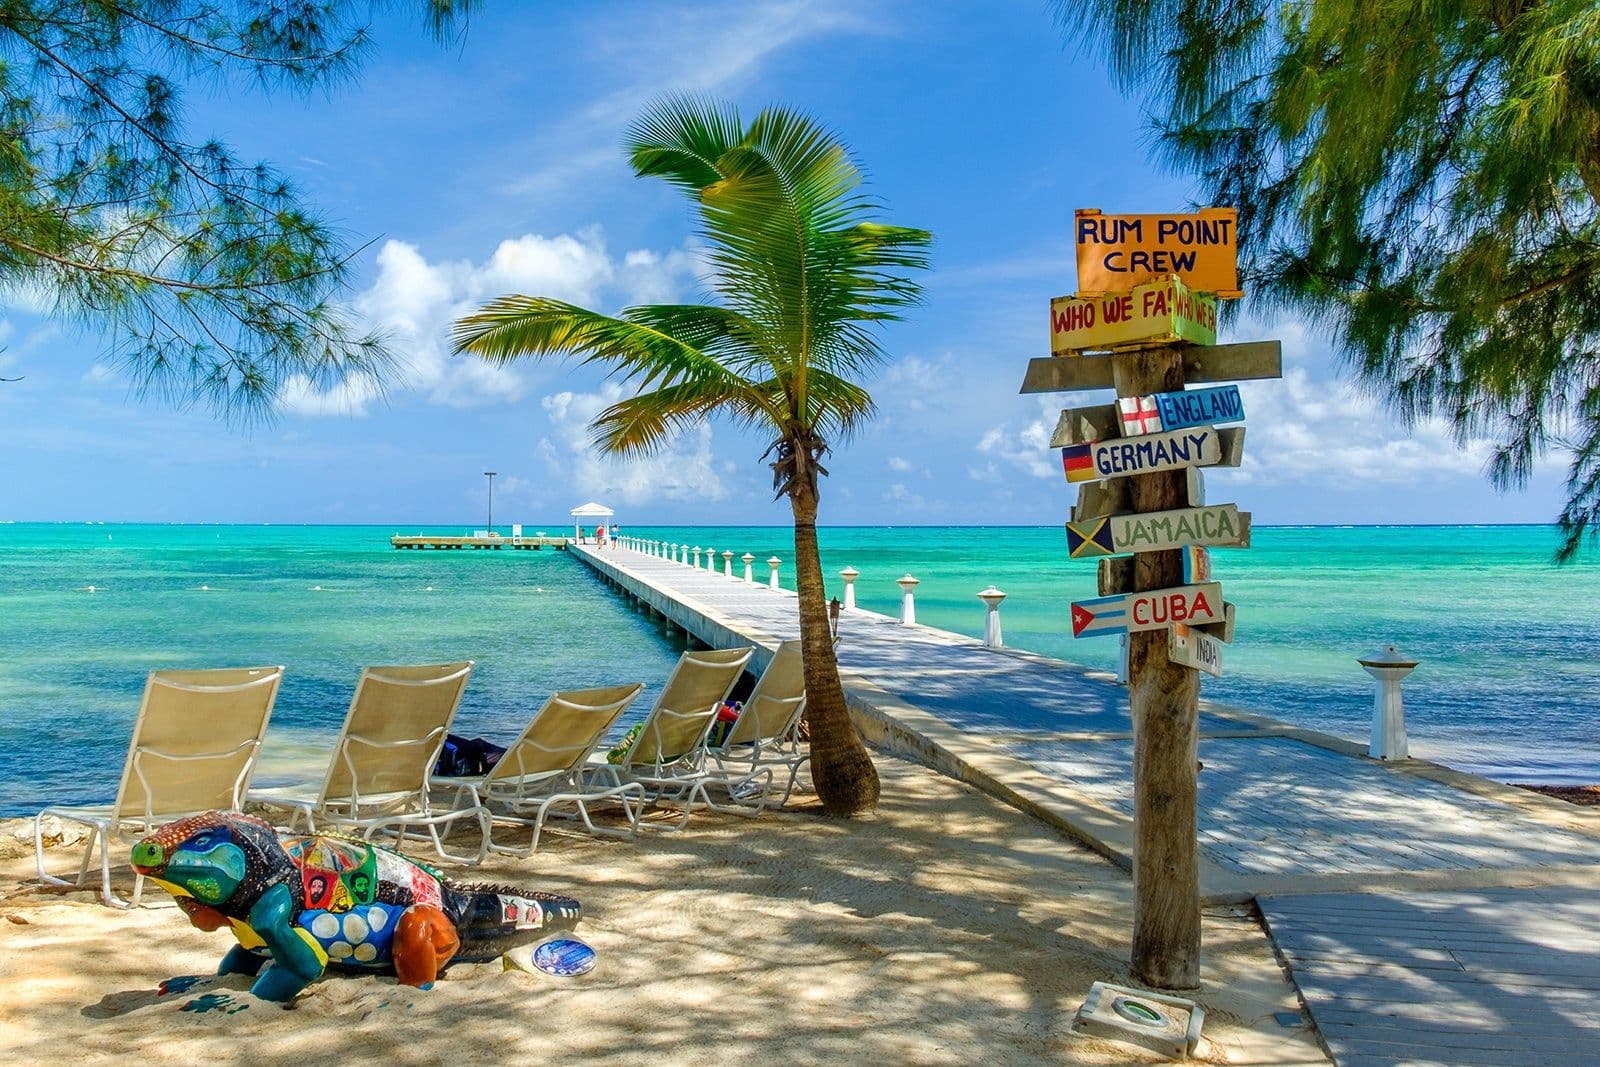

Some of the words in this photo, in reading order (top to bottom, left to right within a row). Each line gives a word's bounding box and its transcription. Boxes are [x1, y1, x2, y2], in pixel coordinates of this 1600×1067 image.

[1078, 219, 1142, 244] RUM
[1158, 219, 1232, 246] POINT
[1103, 251, 1197, 273] CREW
[1052, 303, 1096, 334] WHO
[1102, 296, 1133, 324] WE
[1176, 293, 1193, 322] WHO
[1195, 299, 1207, 328] WE
[1164, 388, 1240, 426] ENGLAND
[1096, 431, 1208, 475] GERMANY
[1115, 509, 1236, 547] JAMAICA
[1133, 591, 1213, 625] CUBA
[1196, 636, 1217, 667] INDIA
